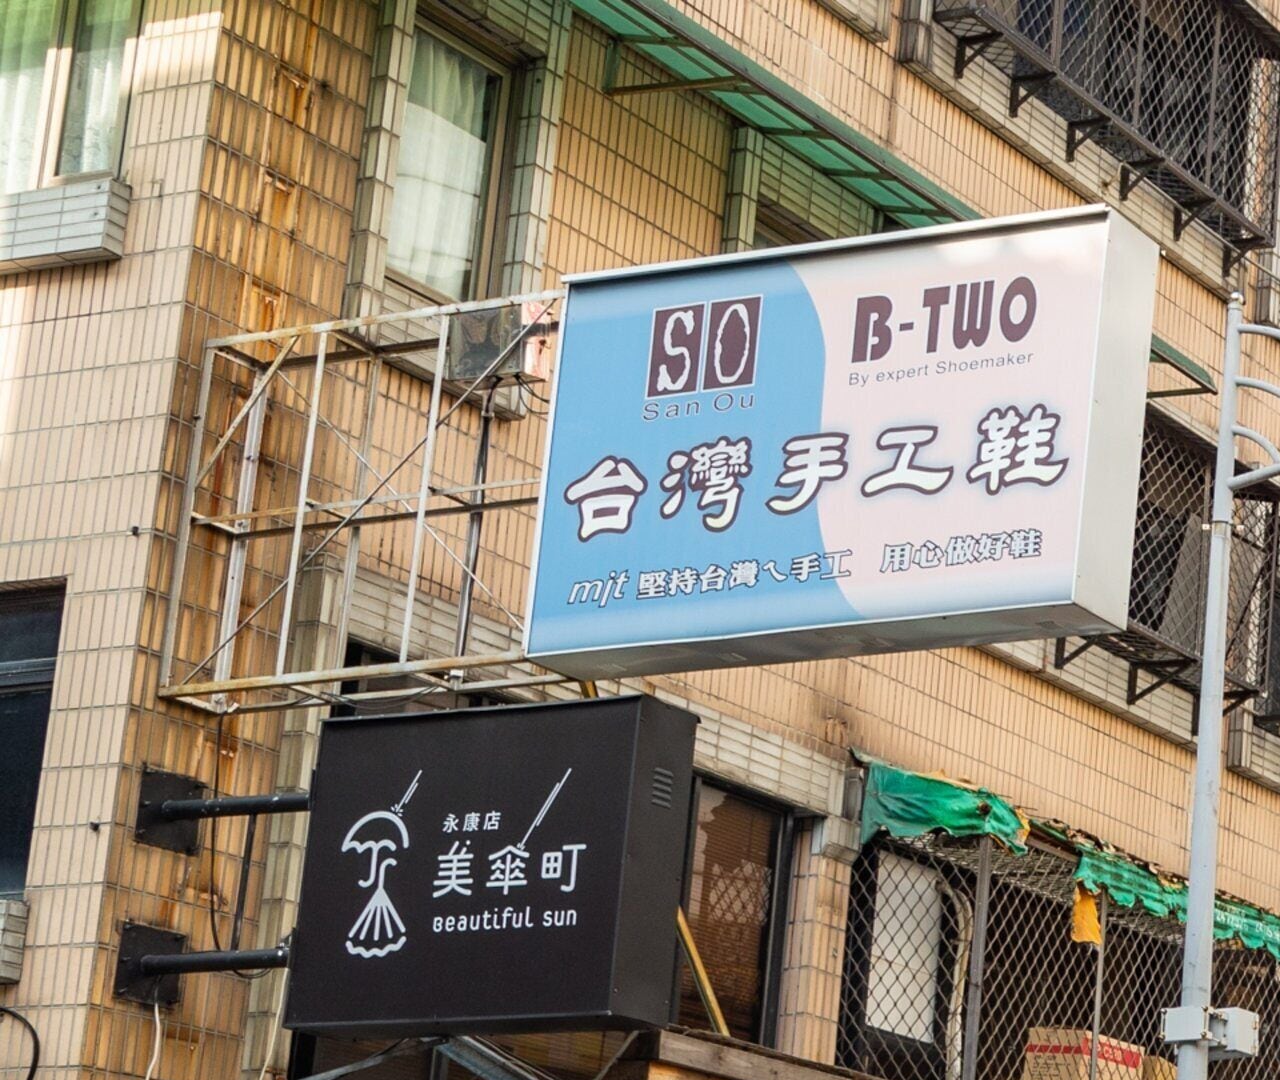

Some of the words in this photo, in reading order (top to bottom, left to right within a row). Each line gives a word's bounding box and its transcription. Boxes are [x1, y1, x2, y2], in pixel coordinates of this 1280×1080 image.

[851, 276, 1037, 363] B-TWO
[648, 297, 760, 398] SO
[848, 369, 871, 387] By
[876, 364, 929, 385] expert
[935, 351, 1034, 377] Shoemaker
[642, 398, 700, 421] San
[712, 392, 756, 414] Ou
[564, 403, 1070, 542] 台灣手工鞋
[880, 529, 1042, 574] 用心做好鞋
[442, 810, 502, 834] 永康店
[432, 840, 588, 899] 美傘町
[432, 905, 534, 934] Beautiful
[542, 908, 578, 928] sun
